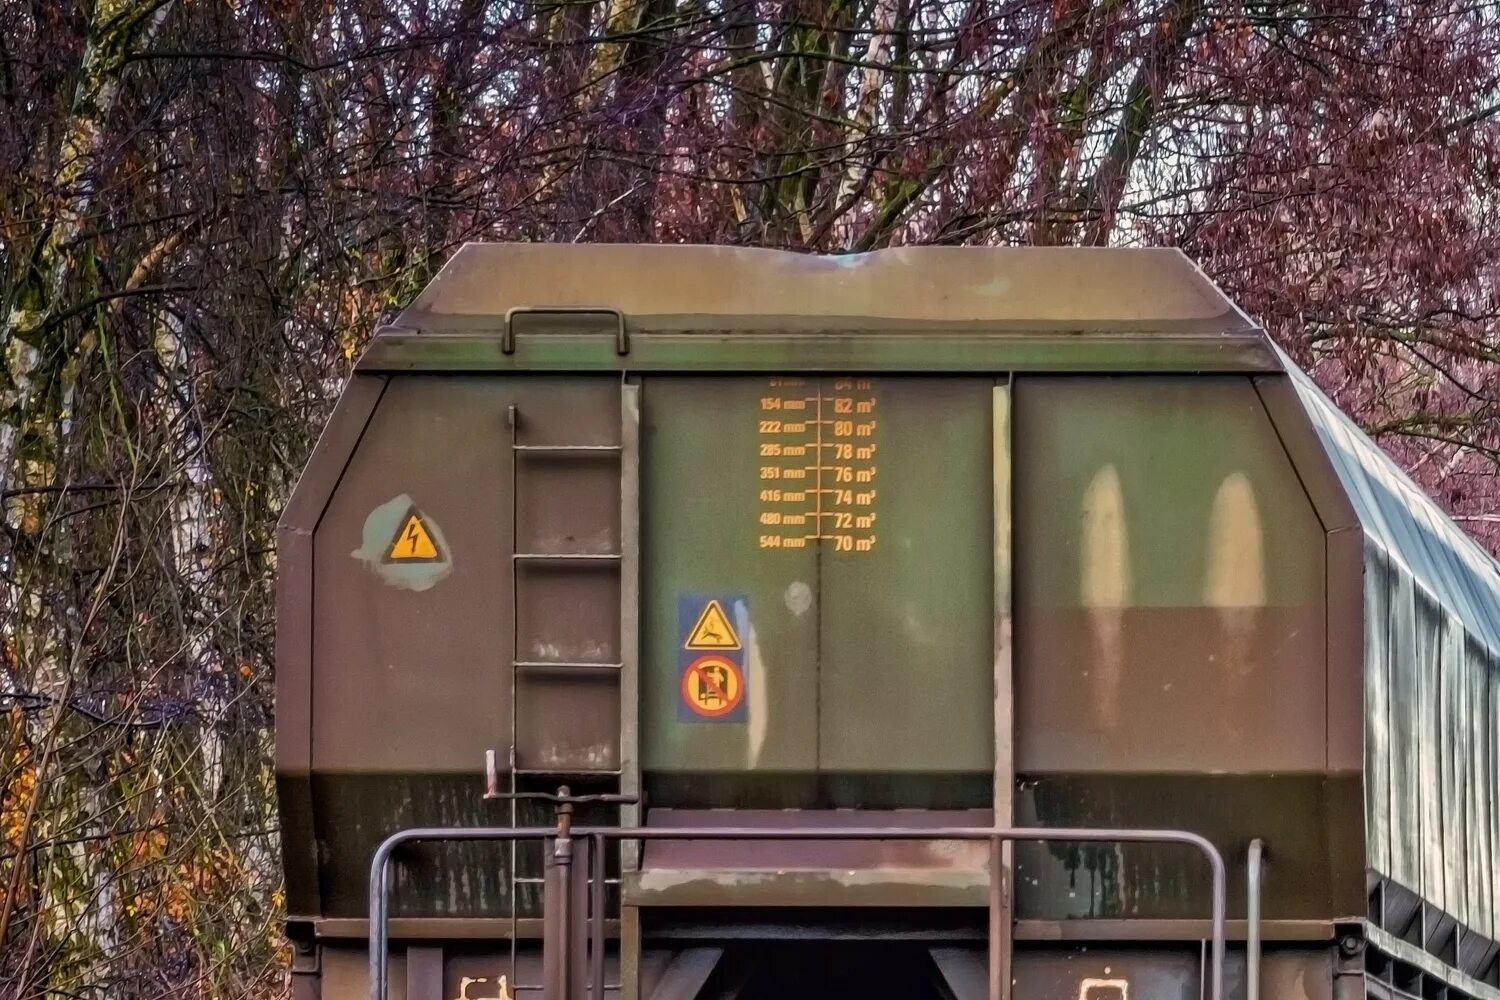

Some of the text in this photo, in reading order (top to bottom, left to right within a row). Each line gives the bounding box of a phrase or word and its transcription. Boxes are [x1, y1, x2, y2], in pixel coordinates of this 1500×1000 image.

[784, 401, 805, 410] mm
[835, 398, 852, 413] 82
[857, 398, 876, 413] m³
[760, 421, 876, 436] 222 mm 80 m³
[760, 444, 876, 459] 285 mm 78 m³
[760, 467, 876, 482] 351 mm 76 m³
[760, 490, 876, 505] 416 mm 74 m³
[760, 513, 876, 528] 480 mm 72 m³
[760, 536, 876, 551] 544 mm 70 m³
